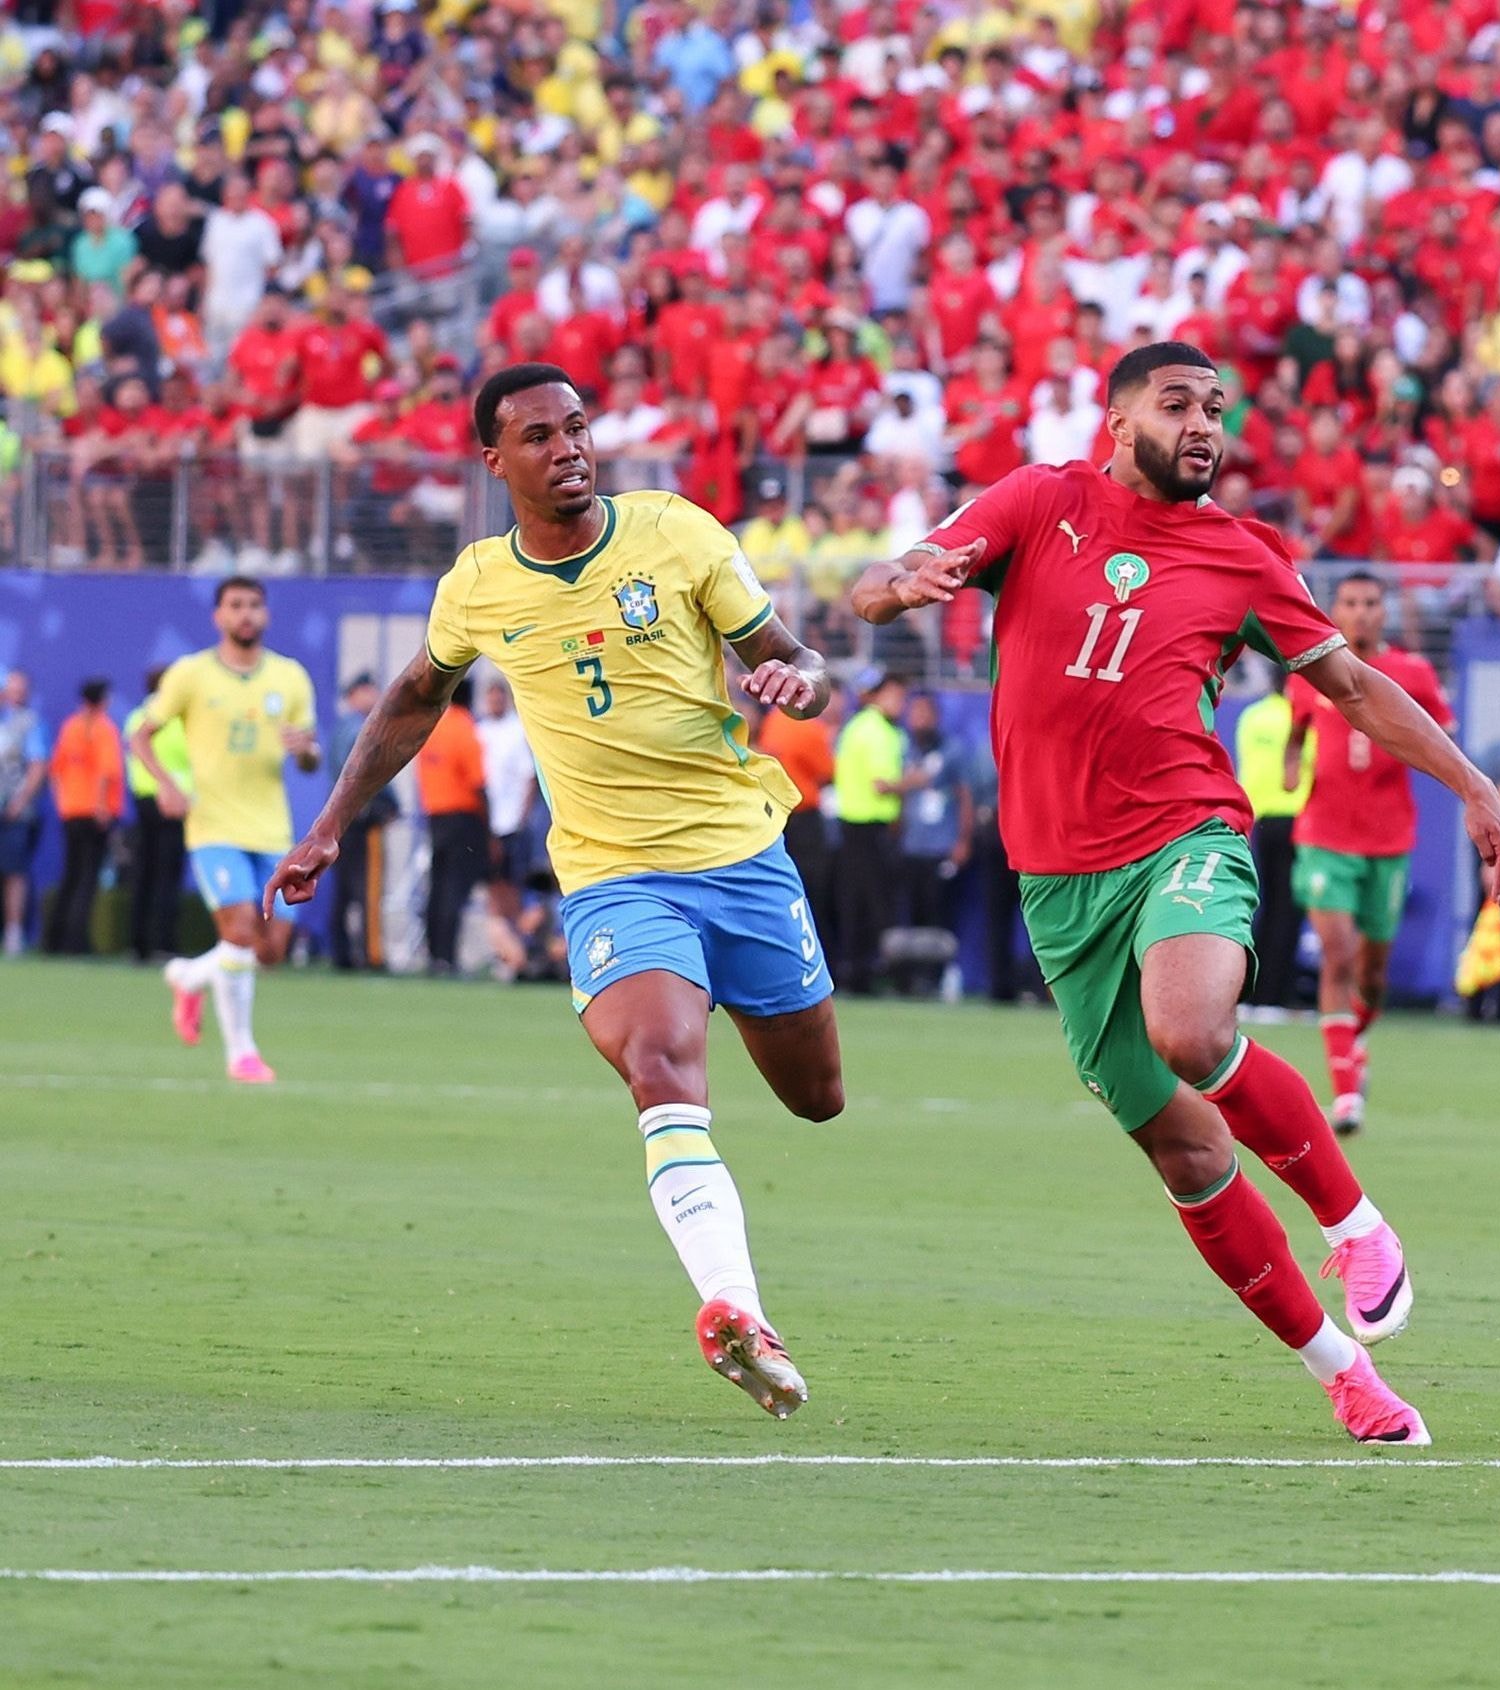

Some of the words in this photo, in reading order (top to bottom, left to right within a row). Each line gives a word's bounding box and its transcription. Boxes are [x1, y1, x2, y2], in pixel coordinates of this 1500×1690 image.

[625, 629, 667, 646] BRASIL
[1064, 602, 1145, 683] 11
[574, 657, 613, 718] 3
[1159, 852, 1222, 896] 11
[789, 896, 816, 962] 3
[675, 1200, 719, 1224] BRASIL
